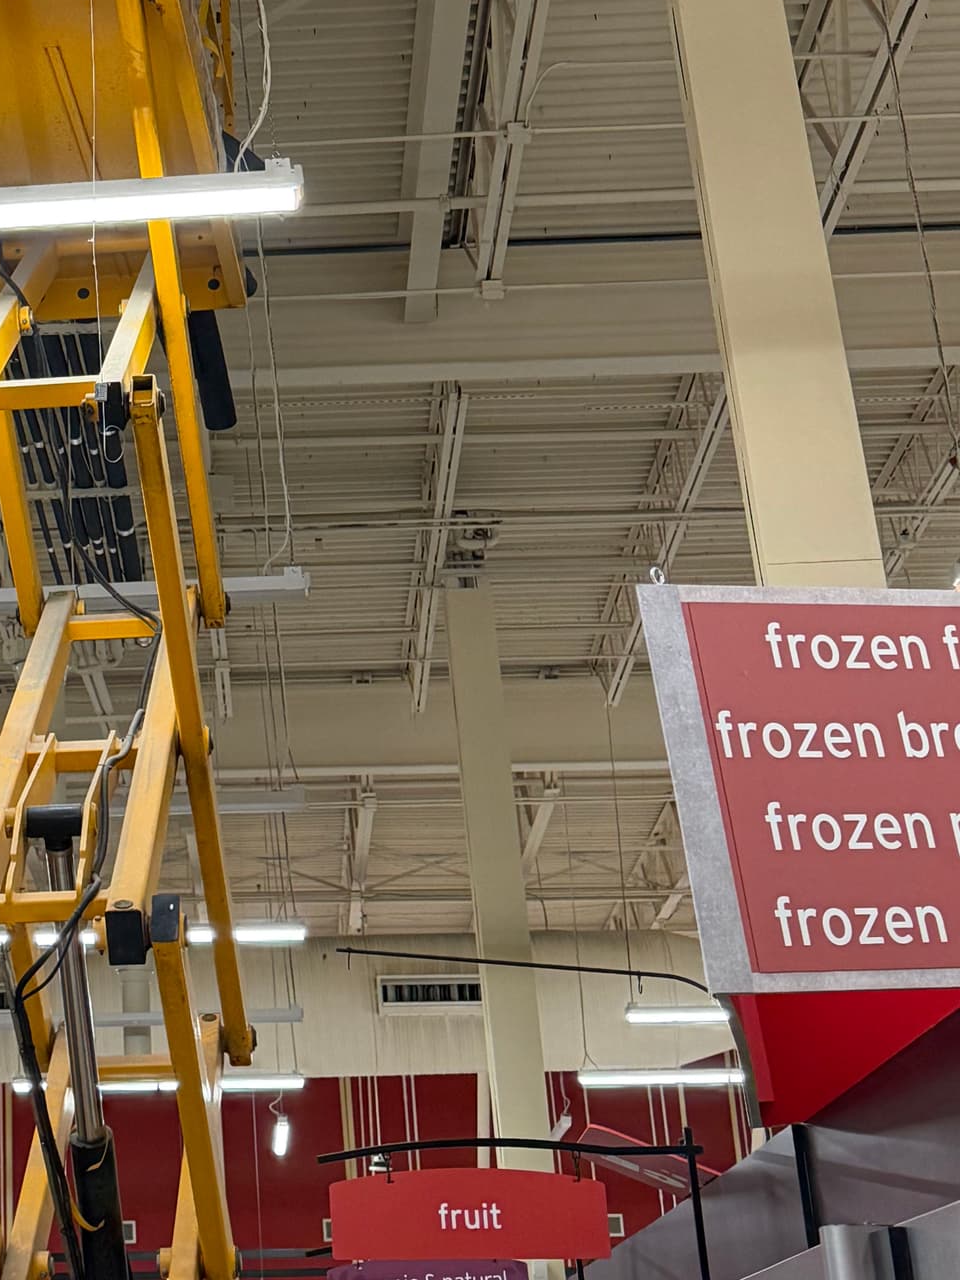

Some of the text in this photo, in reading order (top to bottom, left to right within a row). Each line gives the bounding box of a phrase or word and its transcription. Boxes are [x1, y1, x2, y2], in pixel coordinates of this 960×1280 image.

[764, 621, 931, 669] frozen
[715, 710, 960, 759] frozen br
[764, 801, 936, 851] frozen
[774, 895, 948, 946] frozen
[438, 1202, 502, 1229] fruit
